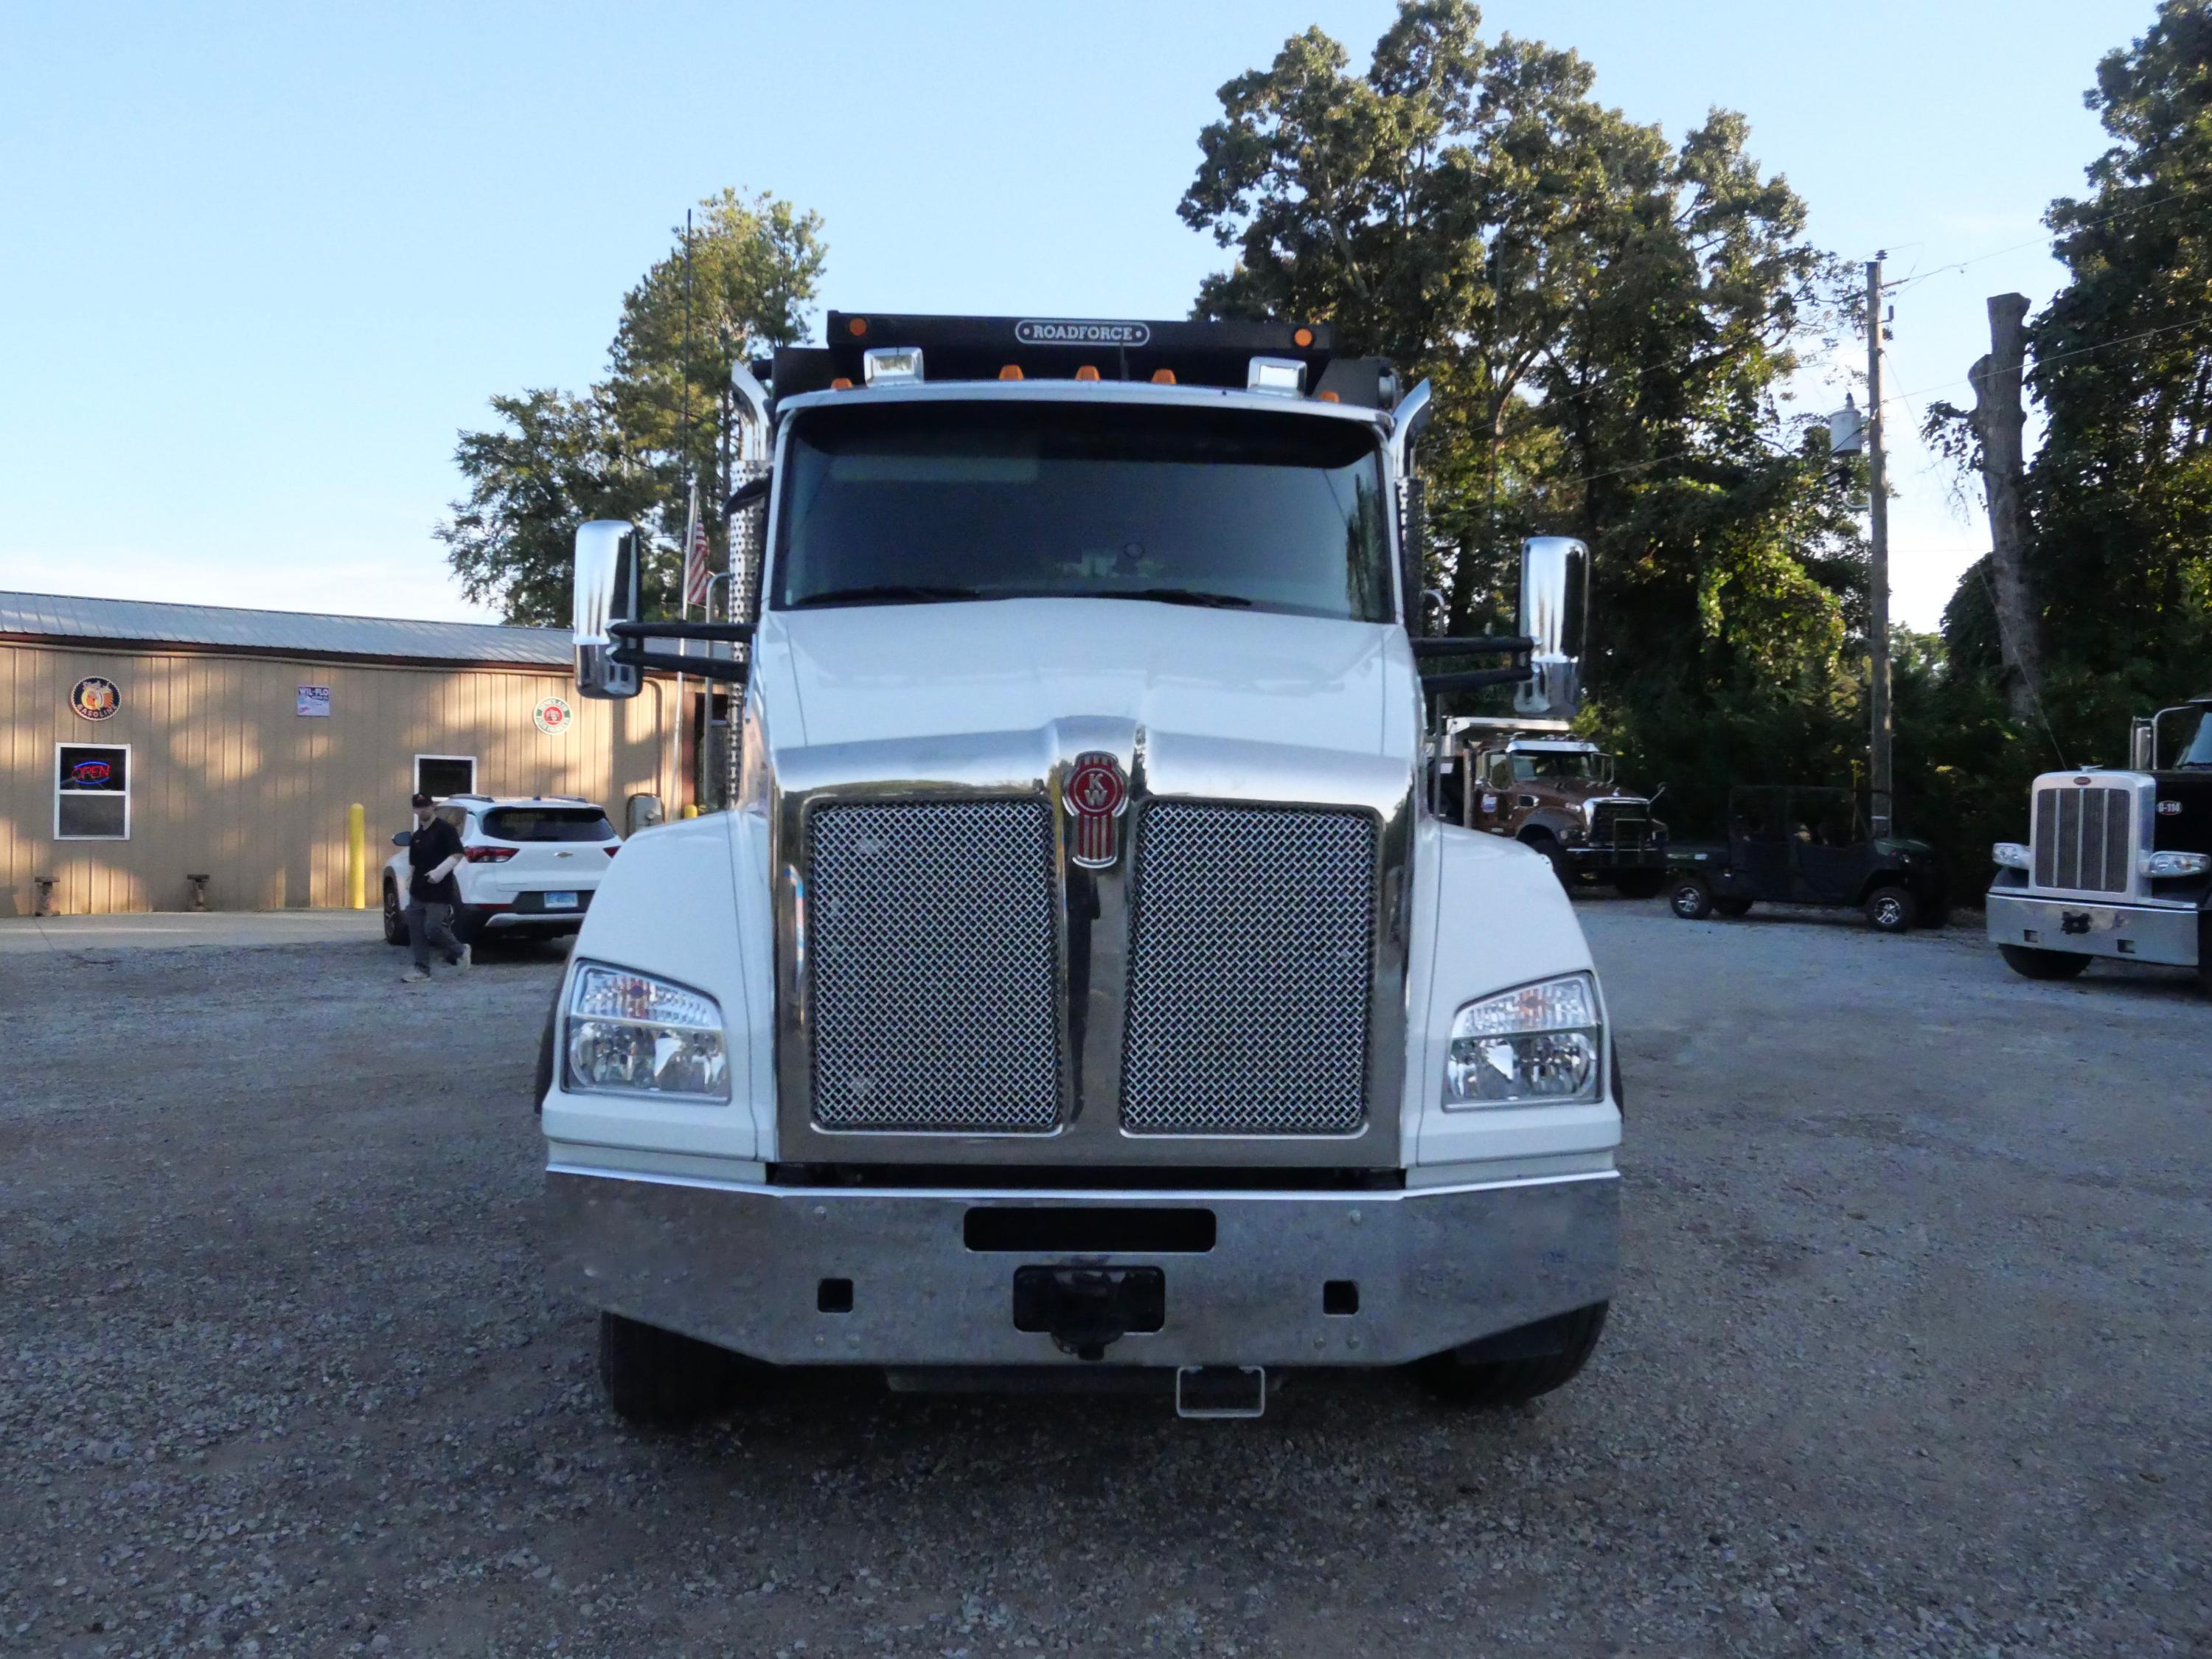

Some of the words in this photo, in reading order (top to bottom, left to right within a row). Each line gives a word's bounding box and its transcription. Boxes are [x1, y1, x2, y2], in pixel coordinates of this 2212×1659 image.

[1033, 325, 1133, 341] ROADFORCE
[299, 687, 329, 696] WIL-FLO
[72, 765, 110, 779] OPEN
